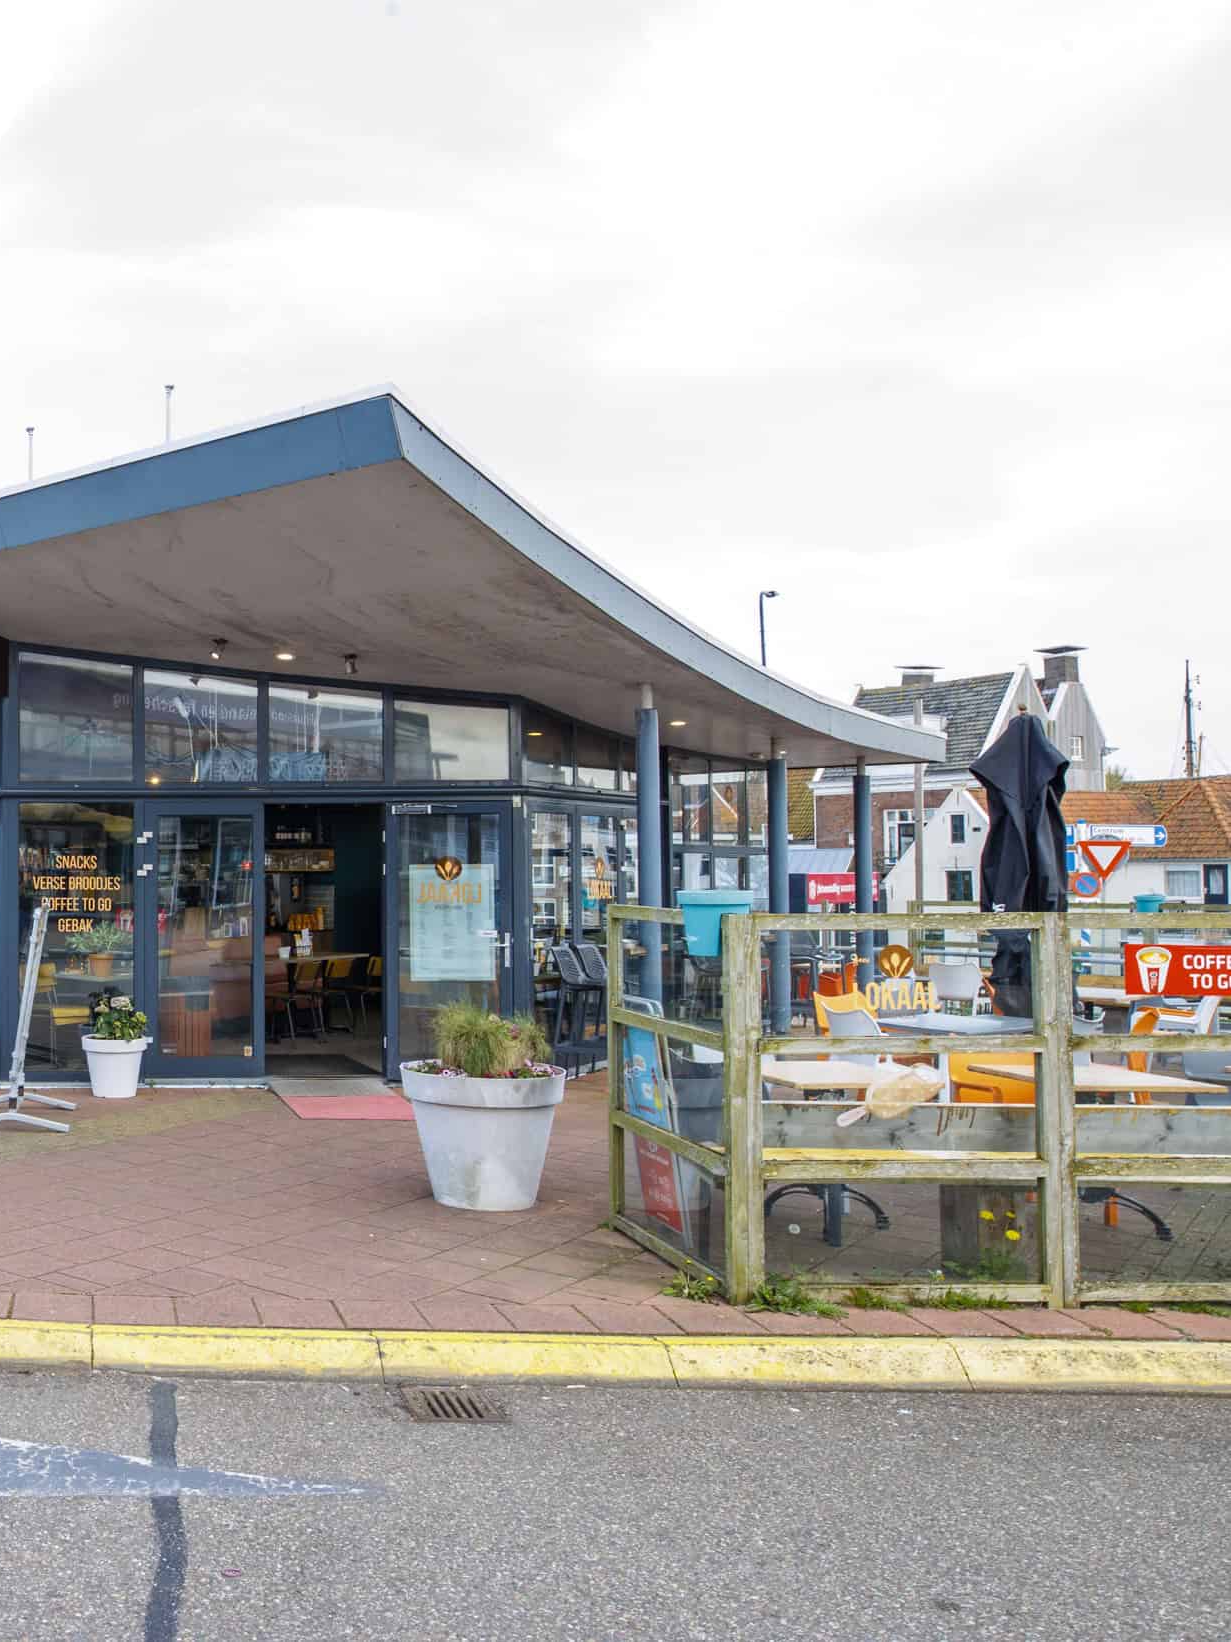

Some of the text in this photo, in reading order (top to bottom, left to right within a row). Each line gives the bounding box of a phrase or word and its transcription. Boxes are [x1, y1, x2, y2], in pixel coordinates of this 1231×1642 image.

[55, 855, 98, 870] SNACKS
[32, 875, 121, 891] VERSE BROODJES
[81, 897, 96, 911] TO
[97, 897, 112, 911] GO
[57, 918, 94, 933] GEBAK
[1189, 973, 1231, 990] TO G
[853, 981, 942, 1010] LOKAAL
